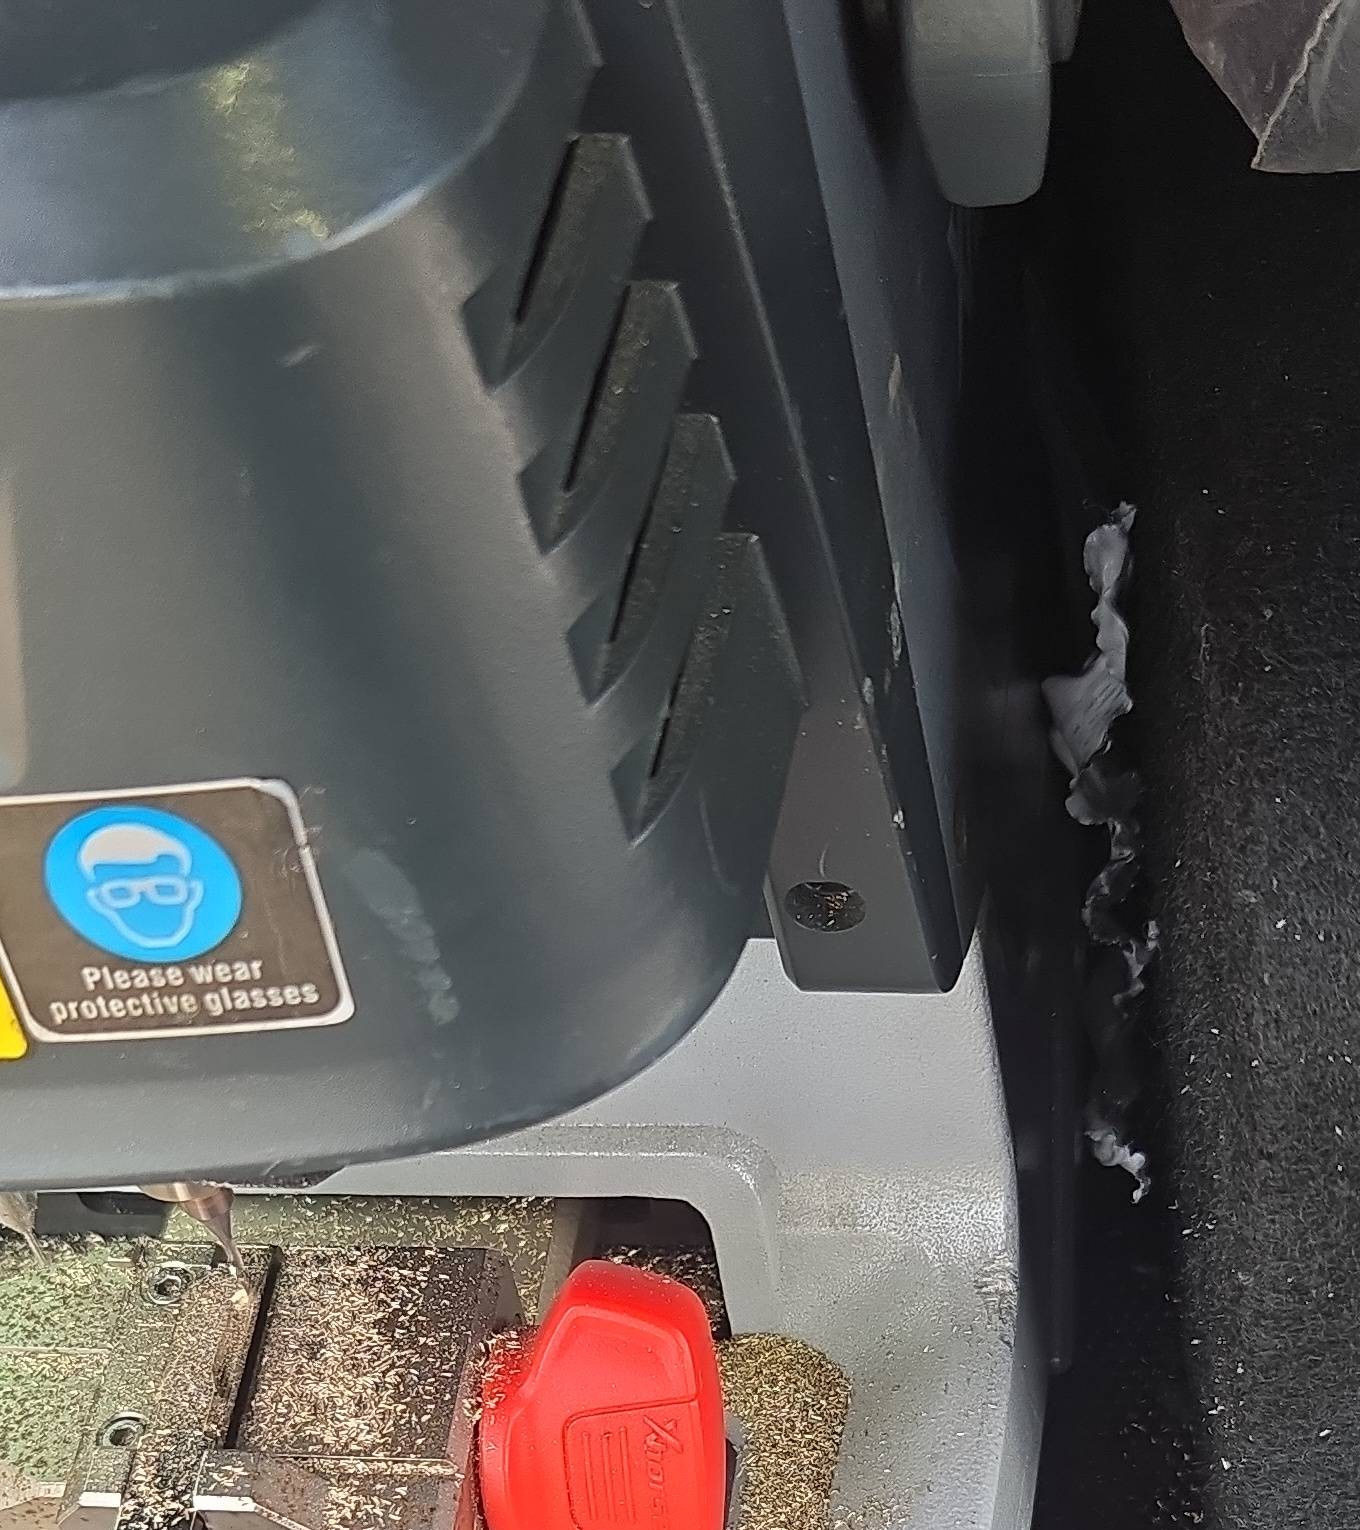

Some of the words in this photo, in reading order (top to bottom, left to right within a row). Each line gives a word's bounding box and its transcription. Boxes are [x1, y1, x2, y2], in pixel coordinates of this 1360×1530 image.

[80, 964, 184, 991] Please
[190, 958, 263, 985] wear
[49, 991, 199, 1025] protective
[202, 982, 321, 1017] glasses
